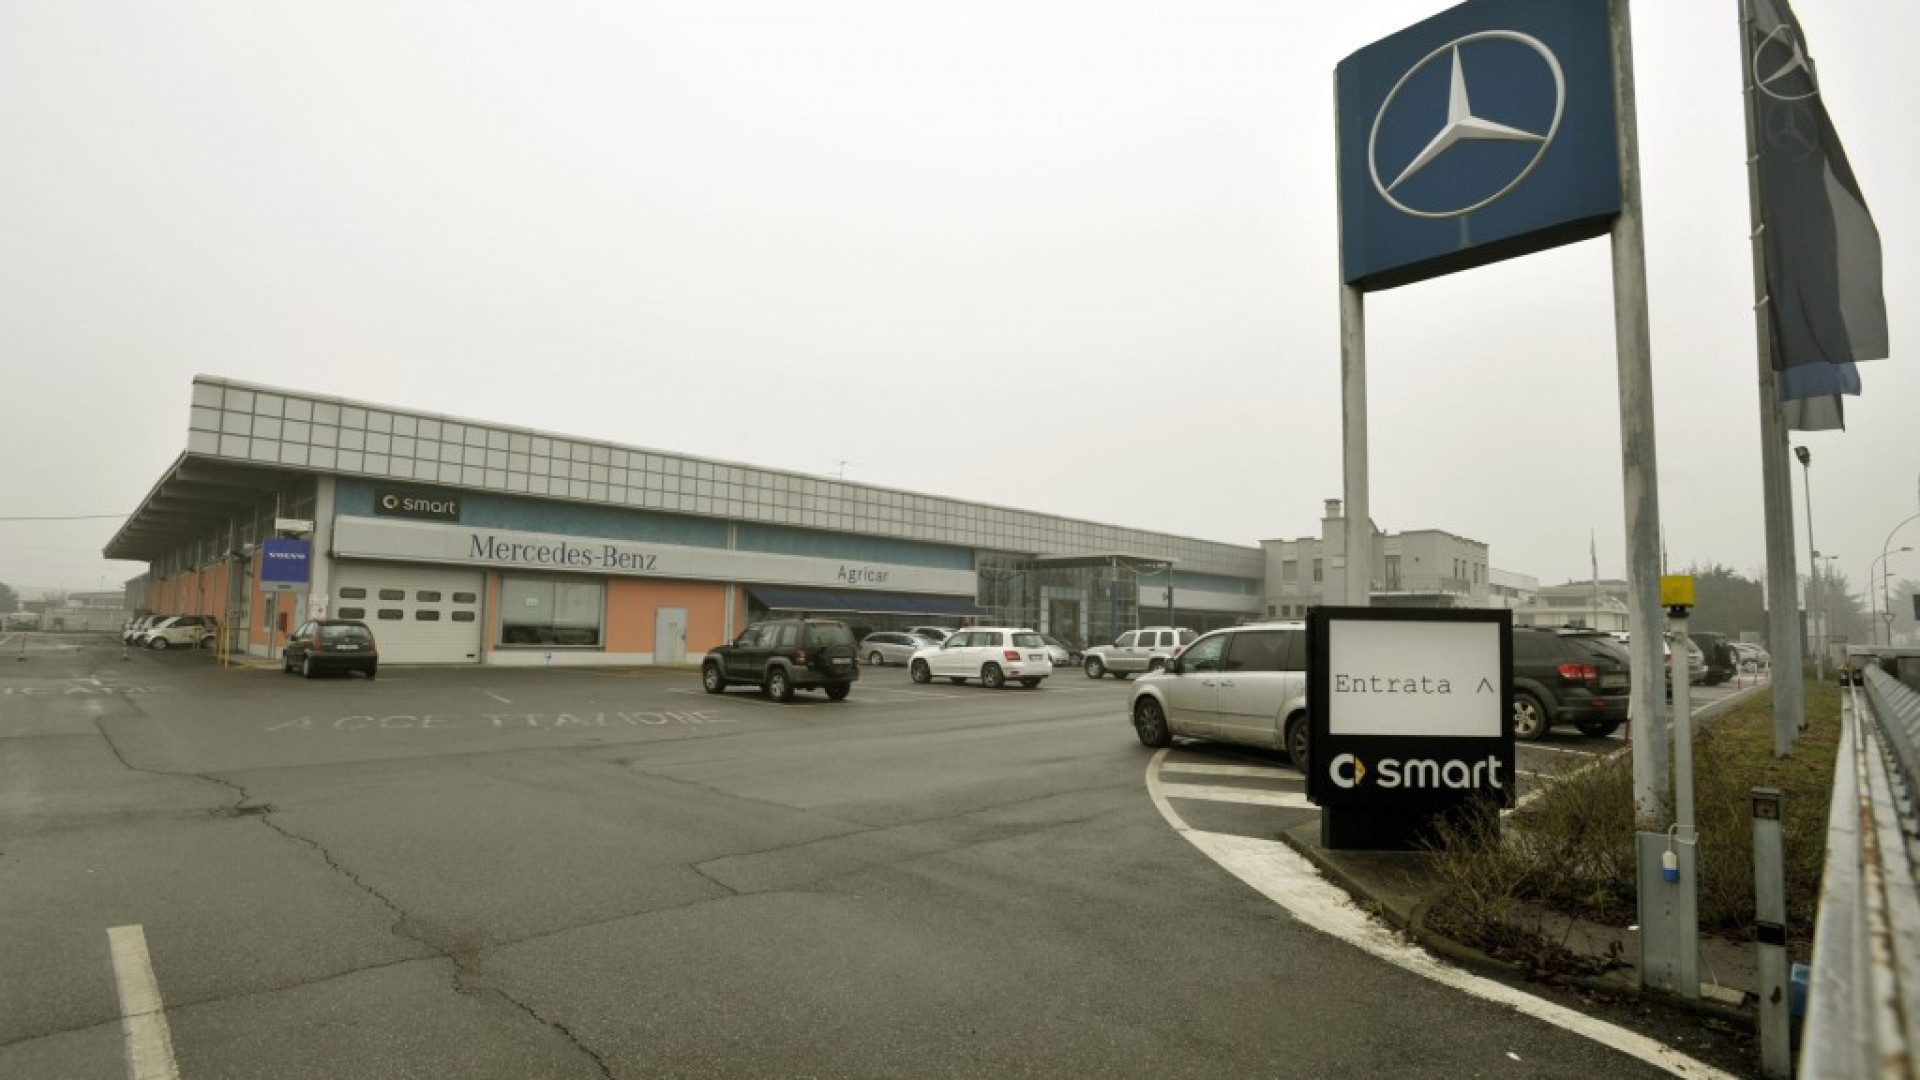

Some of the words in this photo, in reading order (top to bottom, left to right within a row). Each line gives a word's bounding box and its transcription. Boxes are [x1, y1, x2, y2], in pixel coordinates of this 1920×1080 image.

[403, 498, 456, 514] smart
[468, 533, 657, 571] Mercedes-Benz
[837, 564, 888, 583] Agricar
[1335, 674, 1451, 694] Entrata
[1377, 755, 1502, 788] smart
